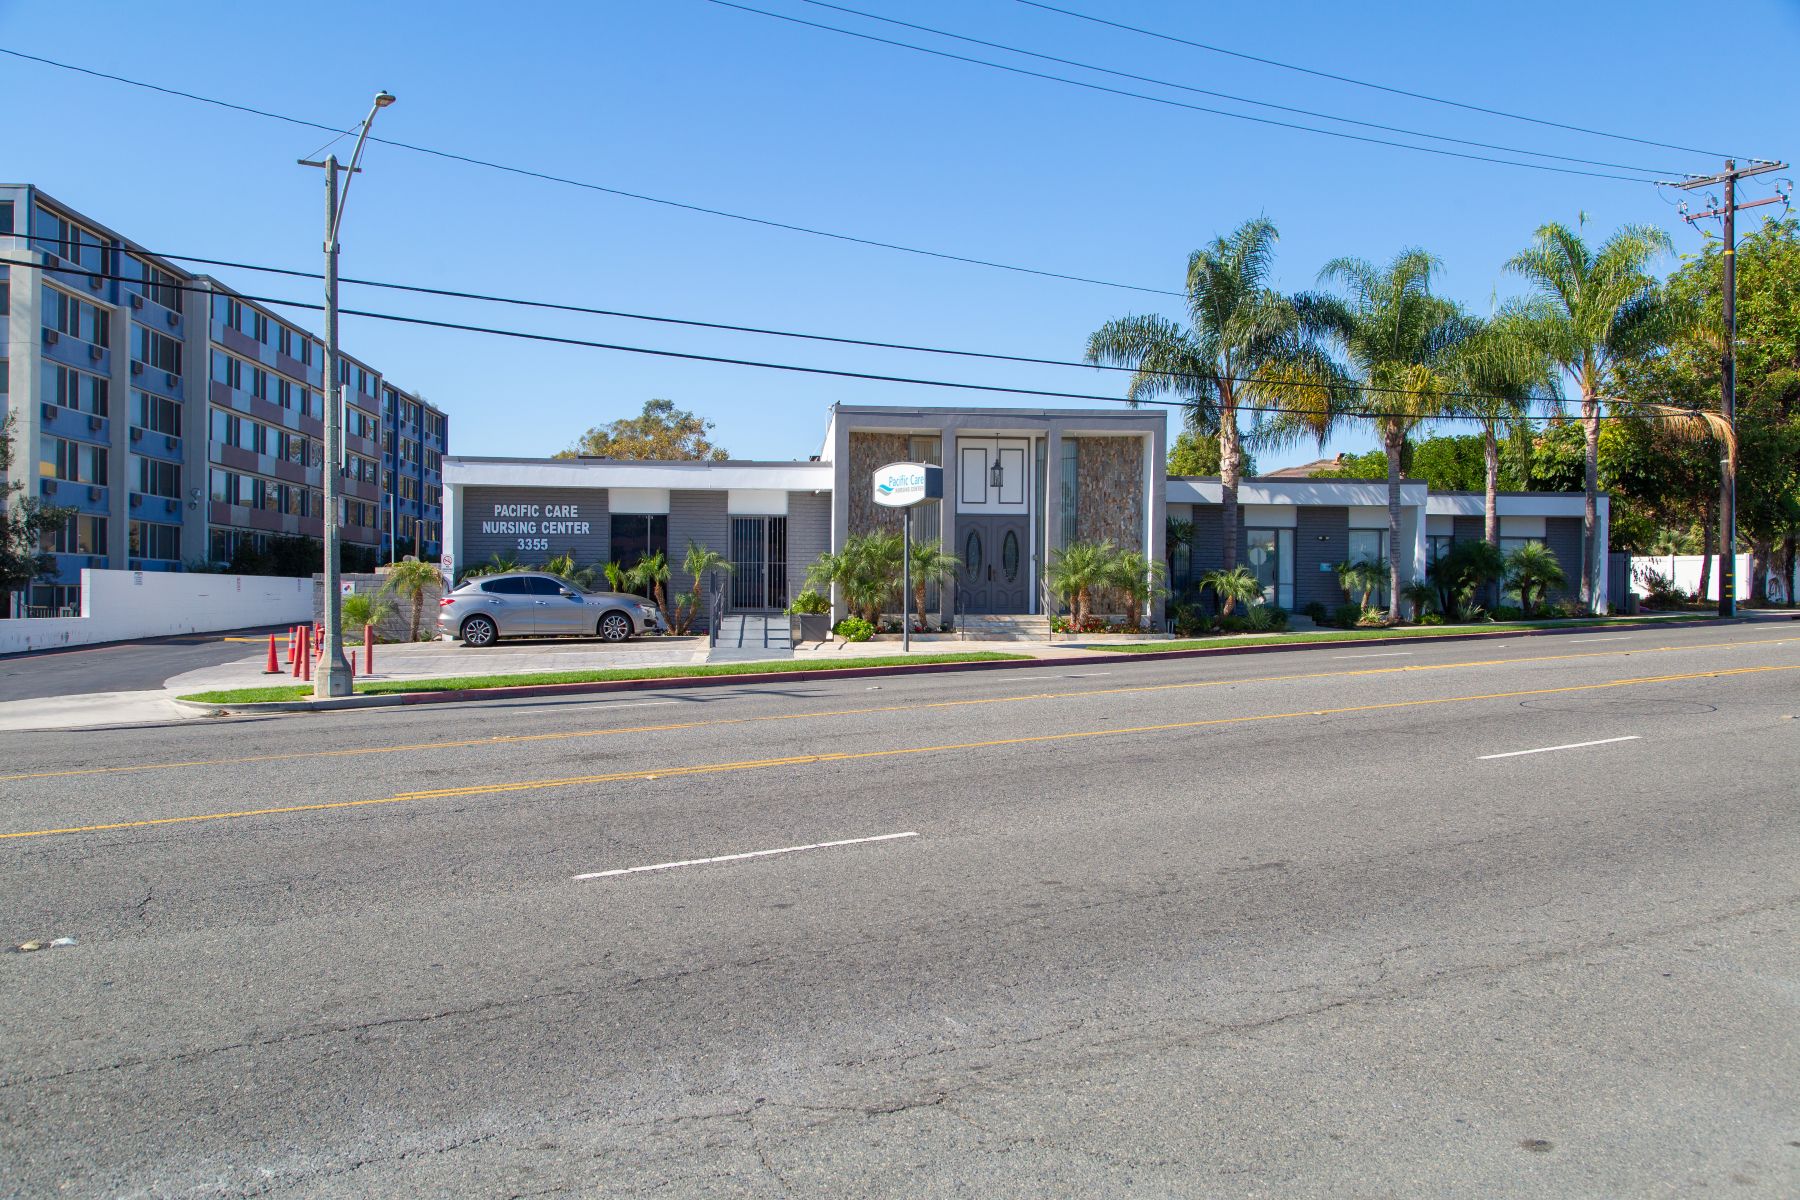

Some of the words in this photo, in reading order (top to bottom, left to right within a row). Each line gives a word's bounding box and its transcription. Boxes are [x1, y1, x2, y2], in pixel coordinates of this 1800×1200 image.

[888, 475, 909, 487] Pacific
[910, 474, 925, 485] Care
[494, 504, 539, 517] PACIFIC
[545, 505, 578, 518] CARE
[482, 521, 537, 534] NURSING
[541, 521, 590, 535] CENTER
[517, 538, 549, 551] 3355
